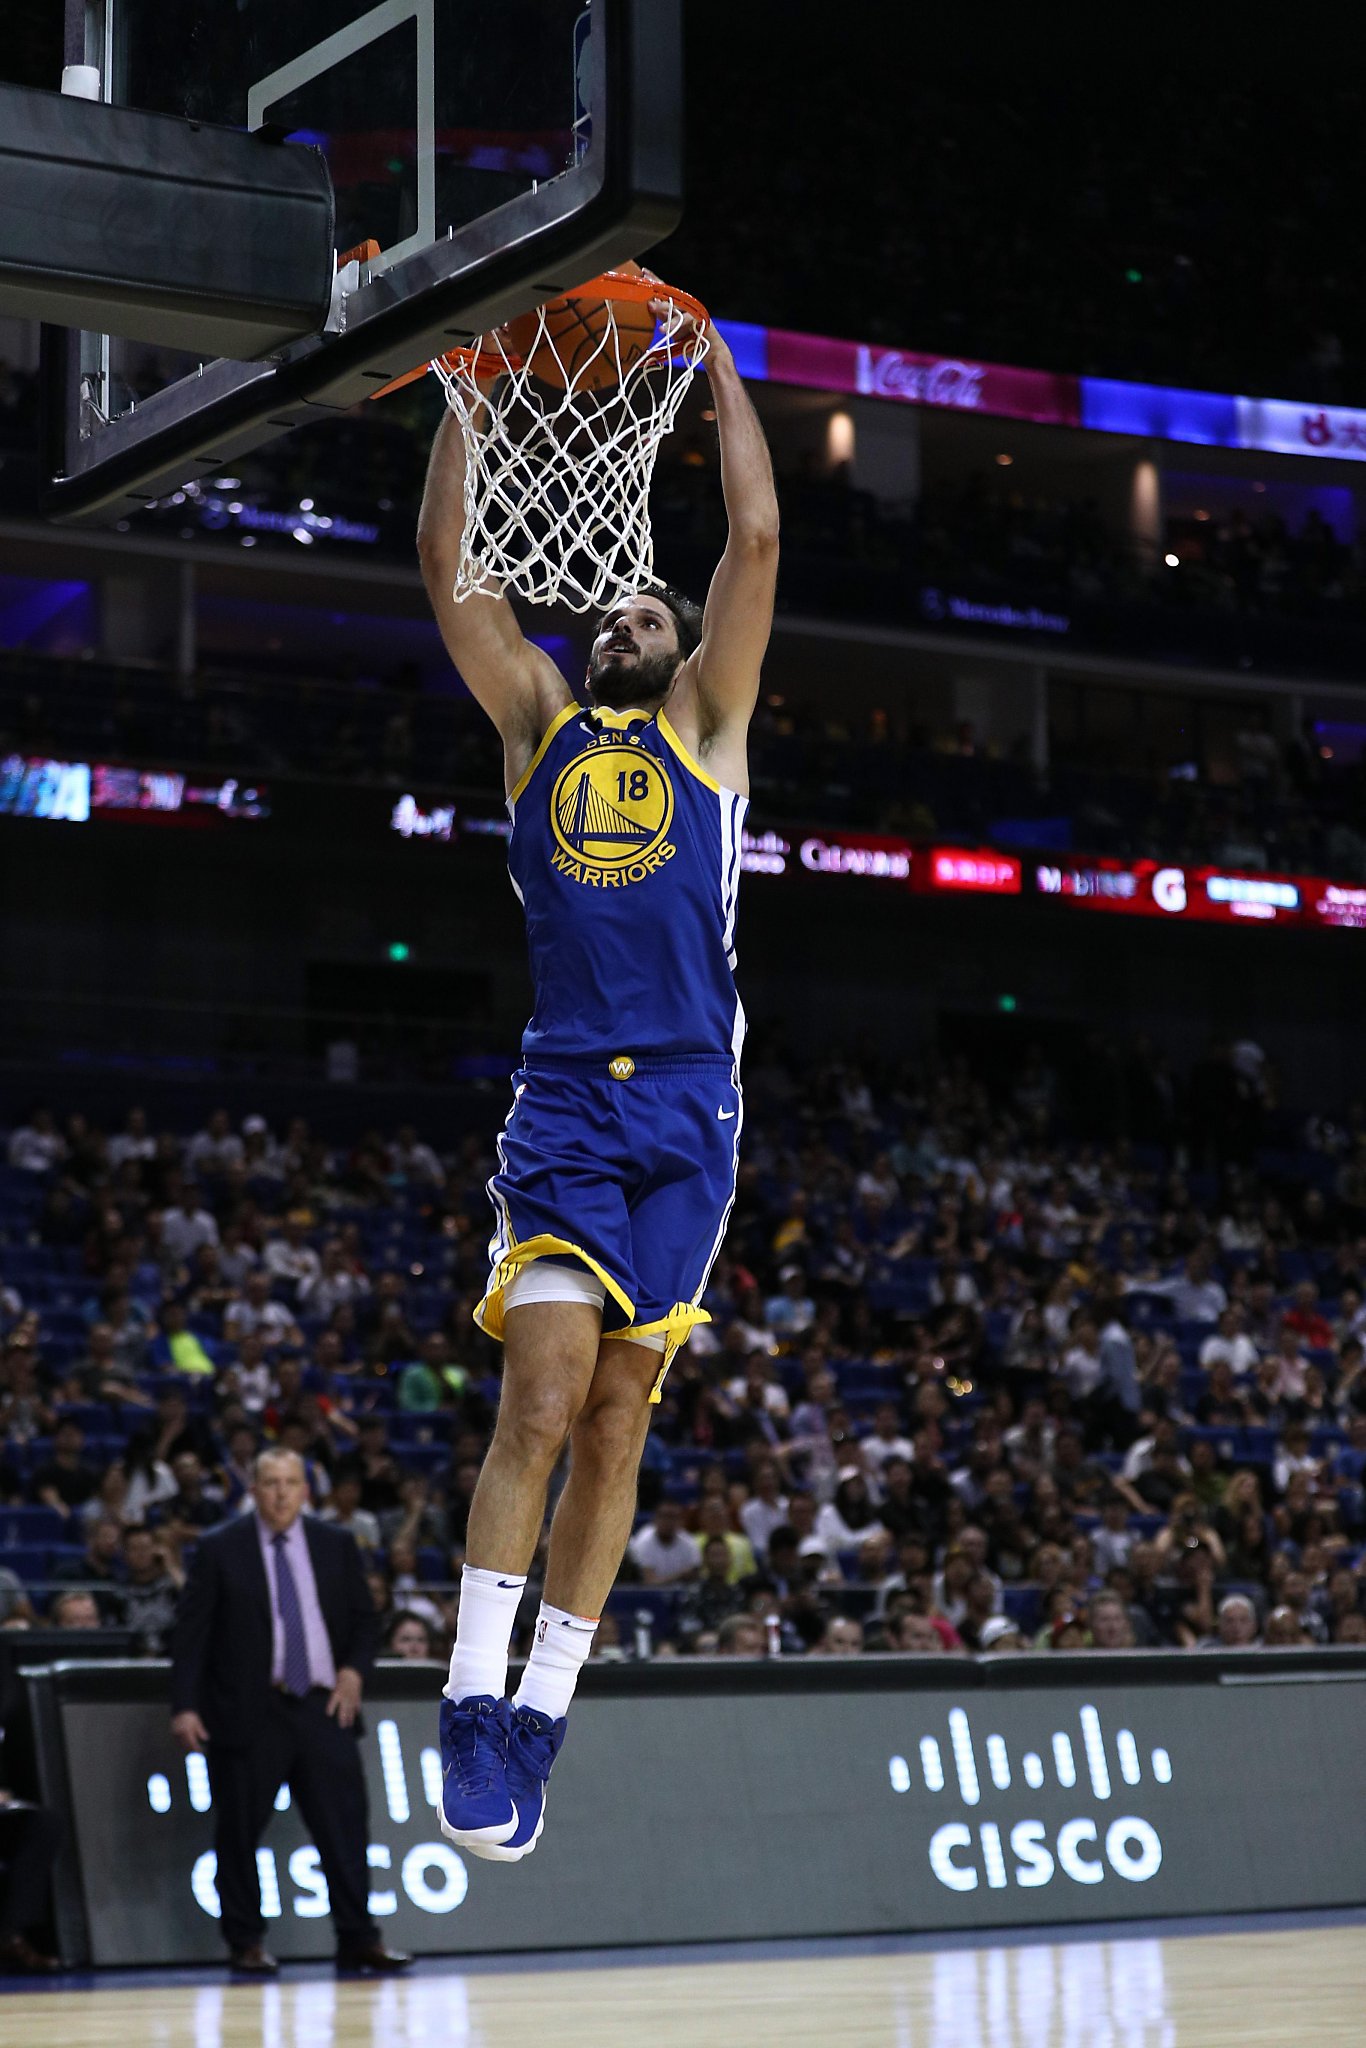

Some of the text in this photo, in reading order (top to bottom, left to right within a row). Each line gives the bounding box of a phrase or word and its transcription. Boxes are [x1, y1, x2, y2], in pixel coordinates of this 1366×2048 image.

[616, 769, 649, 803] 18
[550, 840, 677, 888] WARRIORS
[612, 1061, 632, 1075] W
[929, 1815, 1163, 1891] CISCO
